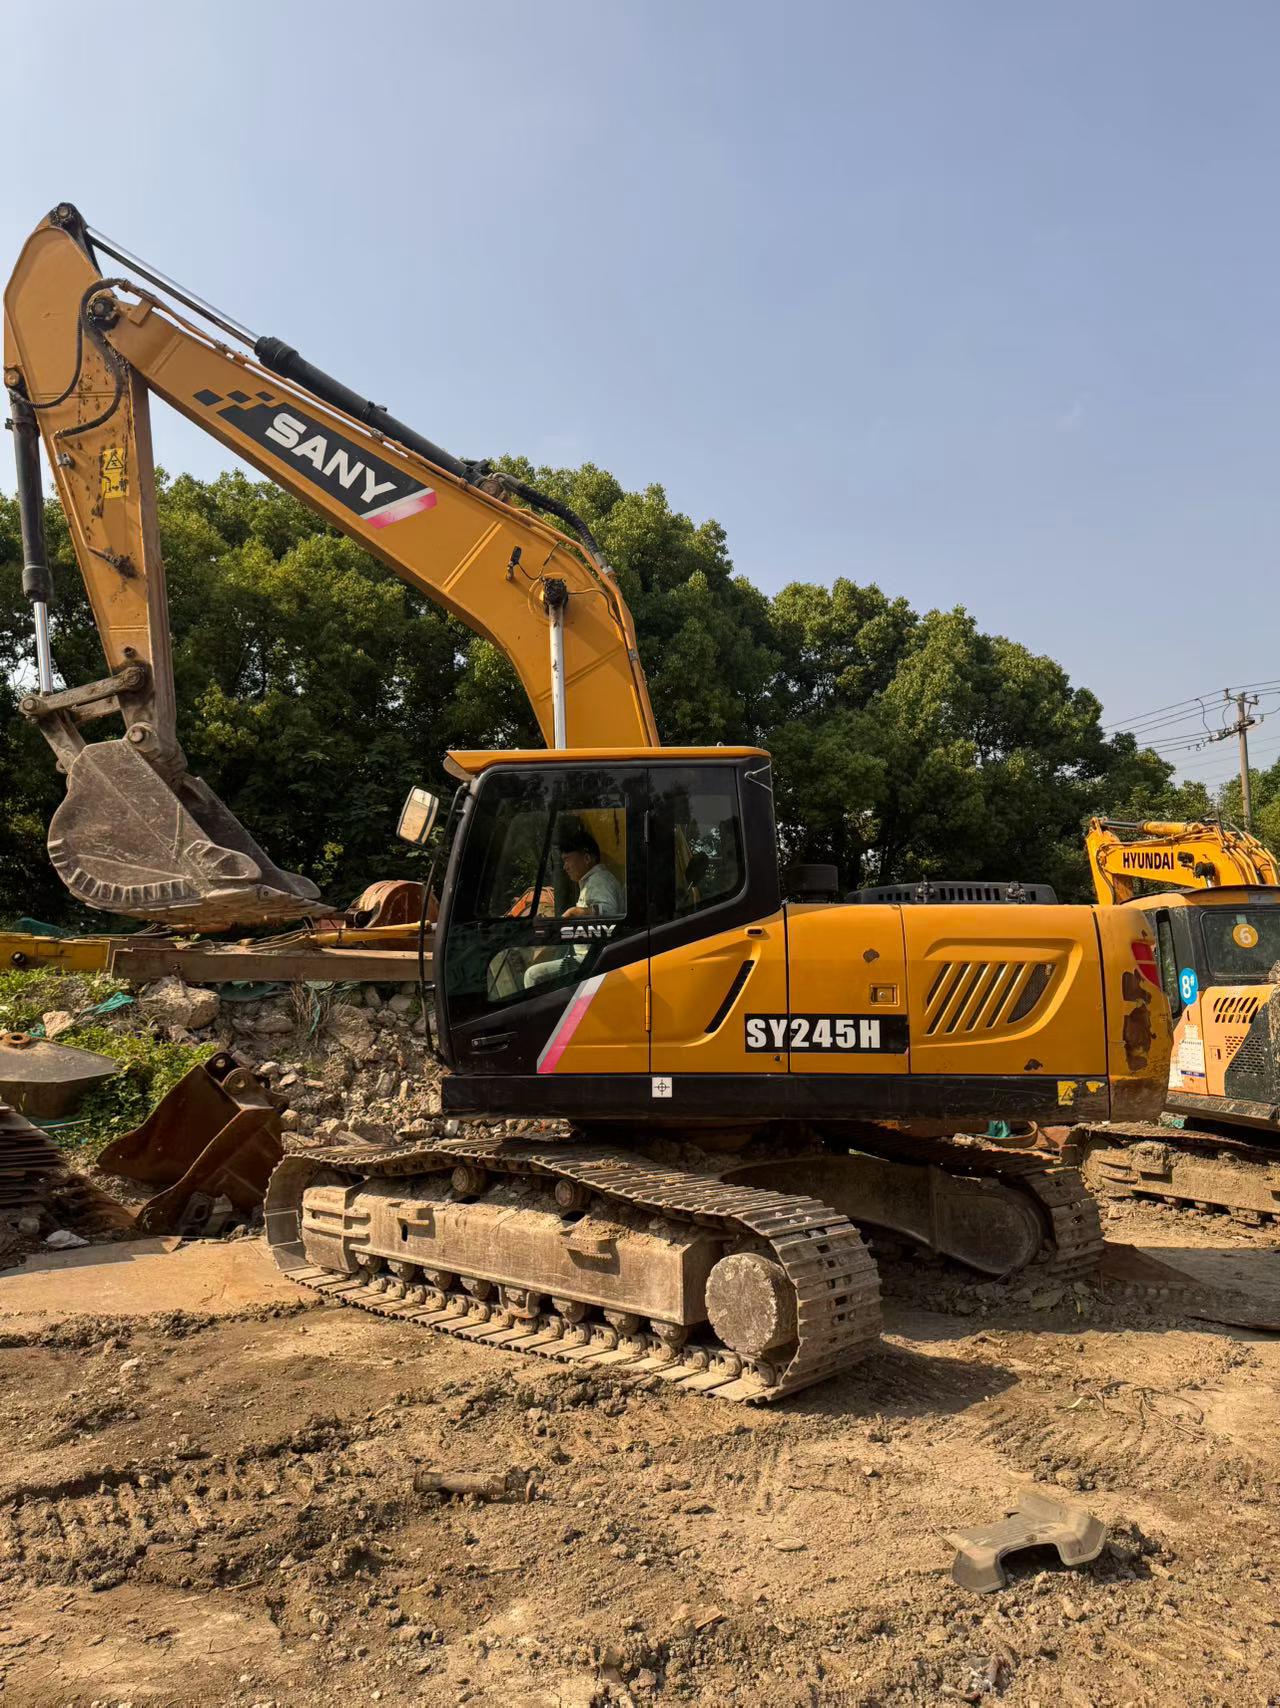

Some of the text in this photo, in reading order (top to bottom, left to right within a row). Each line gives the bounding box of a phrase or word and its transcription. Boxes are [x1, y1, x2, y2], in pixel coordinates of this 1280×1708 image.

[264, 412, 398, 503] SANY
[1122, 852, 1175, 870] HYUNDAI
[560, 924, 617, 939] SANY
[1240, 927, 1252, 945] 6
[746, 1018, 881, 1049] SY245H
